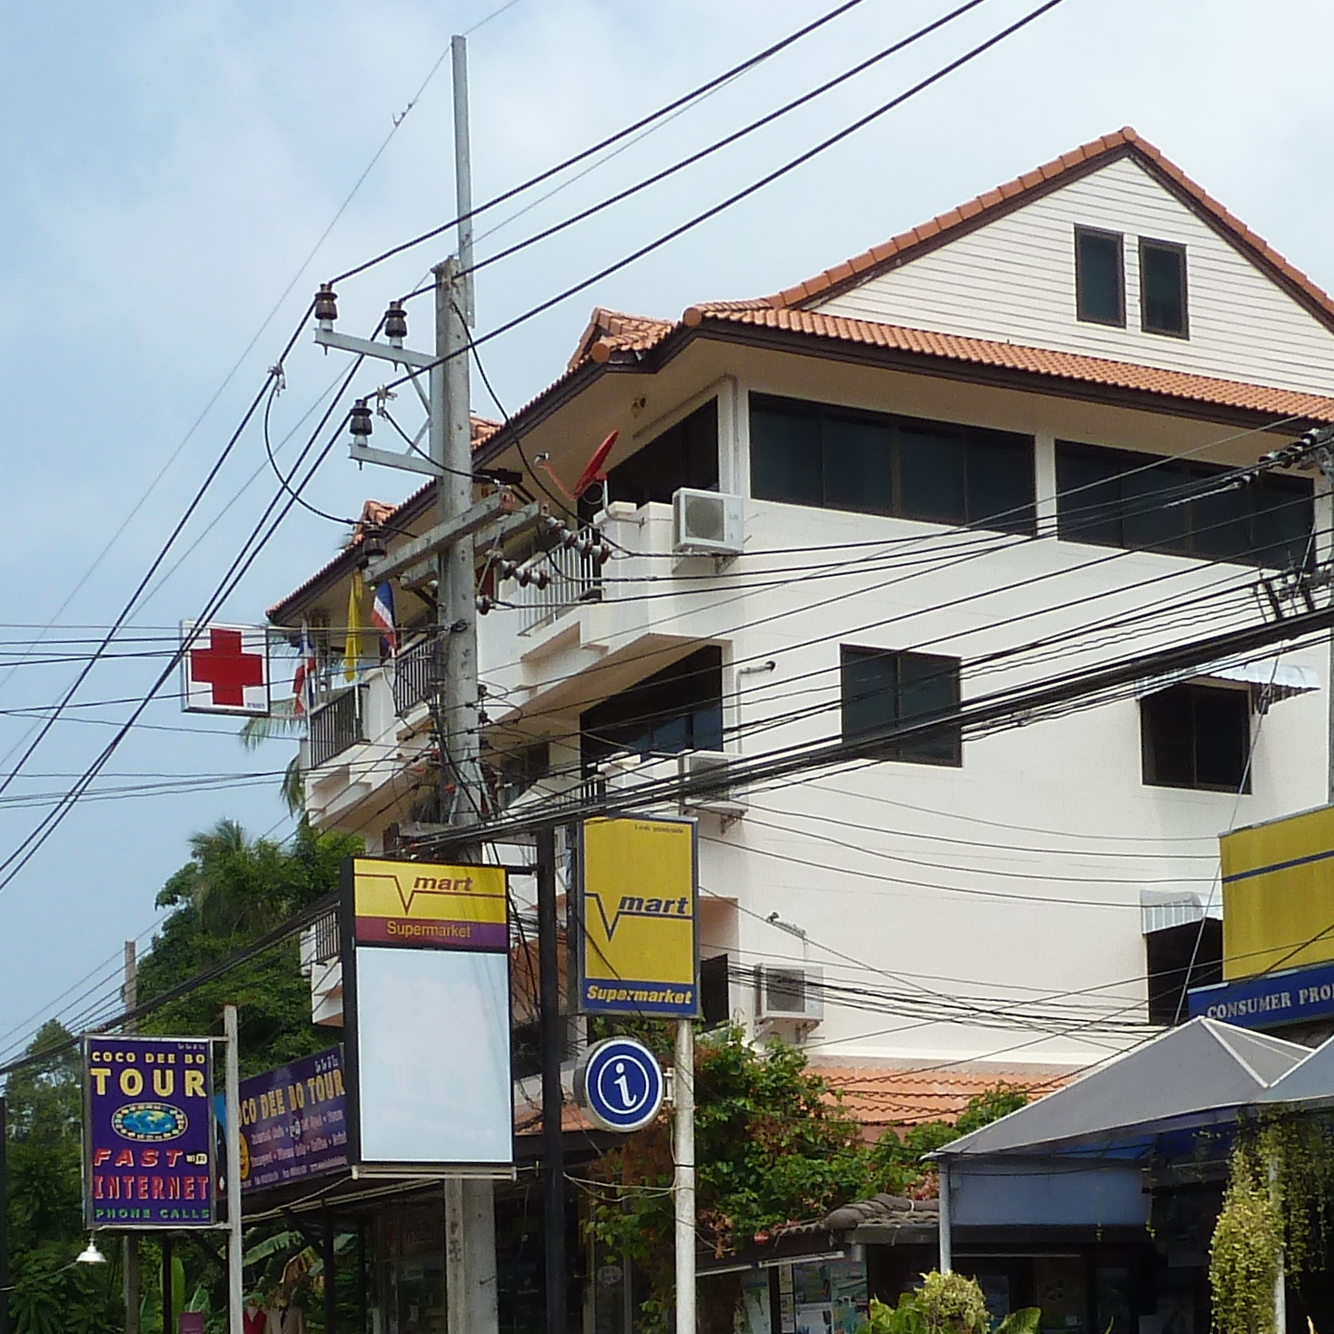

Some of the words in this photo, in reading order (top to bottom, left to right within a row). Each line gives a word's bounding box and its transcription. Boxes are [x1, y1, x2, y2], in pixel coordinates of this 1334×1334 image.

[414, 876, 473, 892] mart
[619, 896, 689, 914] mart
[387, 921, 471, 938] Supermarket
[587, 985, 693, 1005] Supermarket
[1207, 991, 1292, 1019] CONSUMER
[92, 1051, 137, 1063] COCO
[145, 1053, 176, 1064] DEE
[184, 1053, 206, 1065] BO
[90, 1067, 207, 1098] TOUR
[260, 1088, 285, 1120] DEE
[288, 1082, 305, 1111] BO
[307, 1069, 346, 1104] TOUR
[94, 1149, 183, 1168] FAST
[93, 1175, 210, 1200] INTERNET
[96, 1208, 151, 1219] PHONE
[159, 1208, 211, 1219] CALLS
